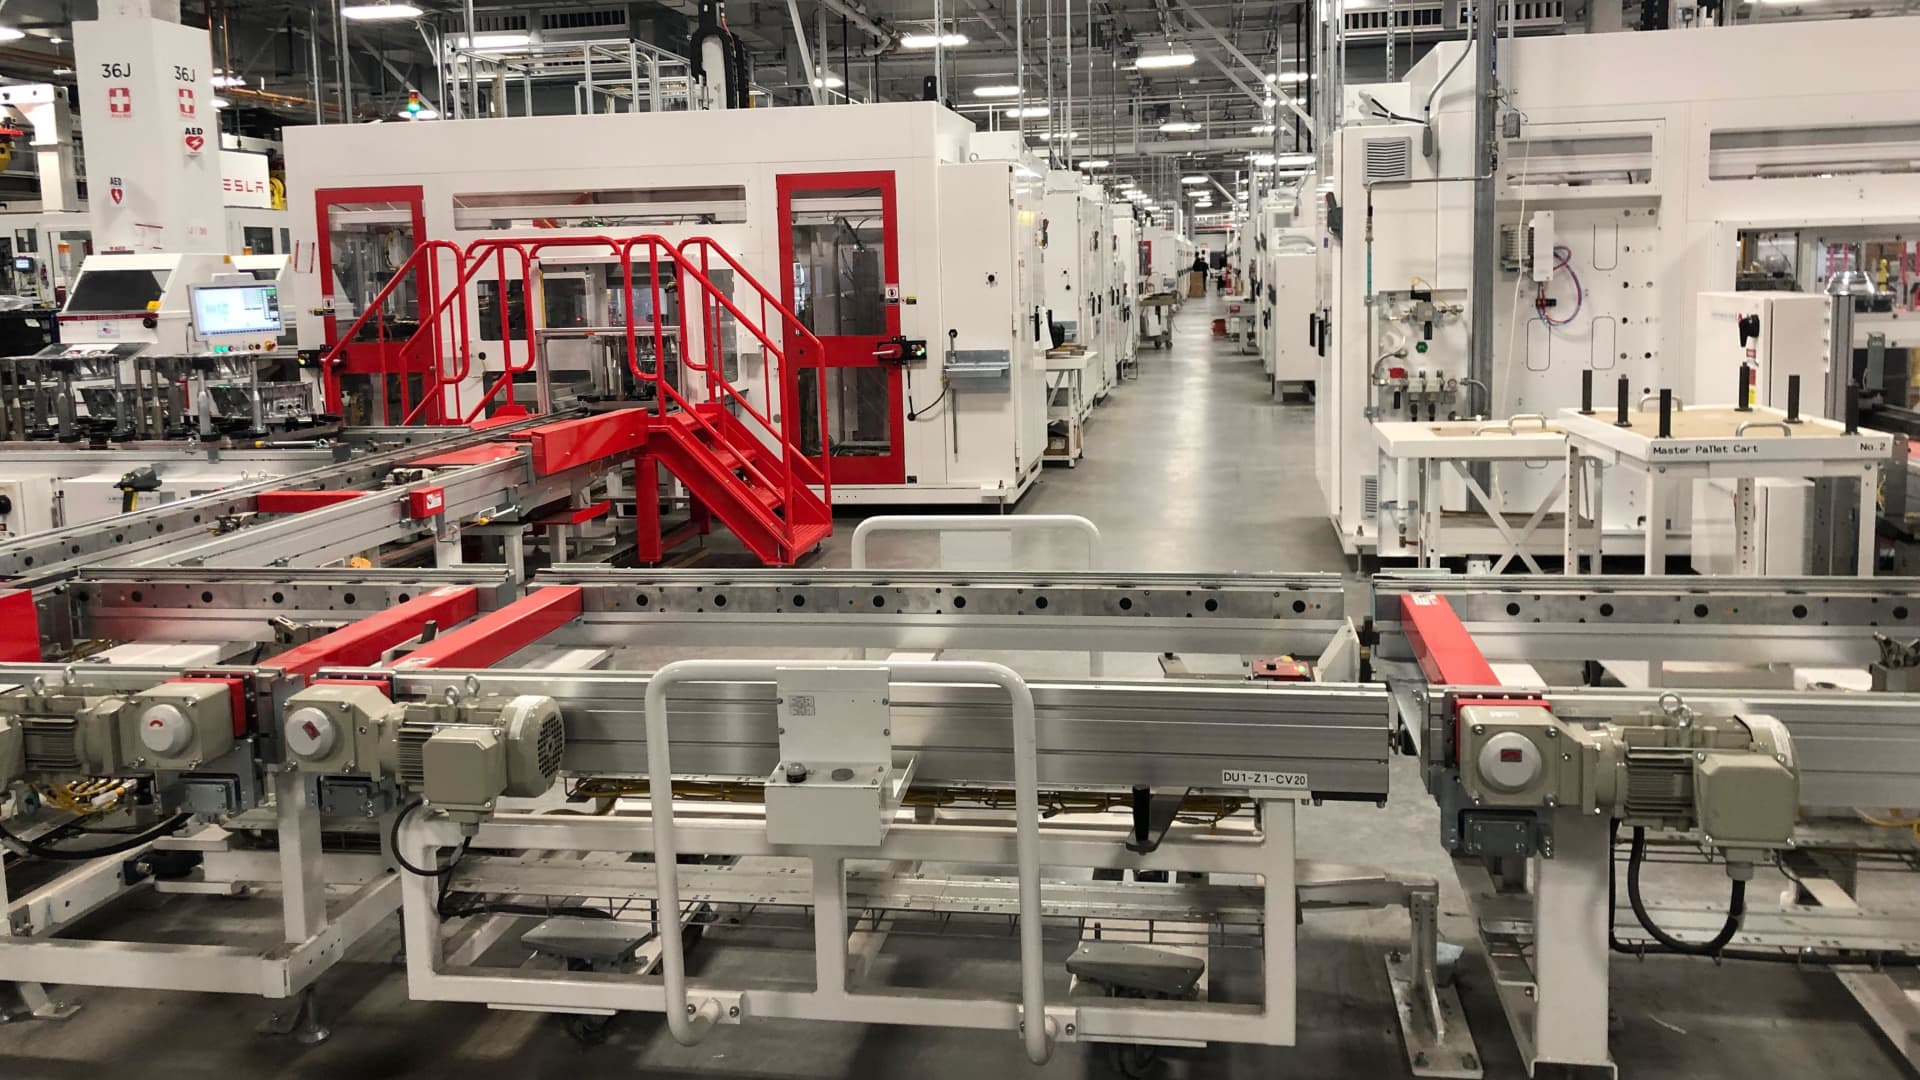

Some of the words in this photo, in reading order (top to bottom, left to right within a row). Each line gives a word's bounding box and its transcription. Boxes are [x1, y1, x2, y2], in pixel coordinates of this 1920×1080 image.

[101, 63, 131, 78] 36J
[174, 65, 196, 82] 36J
[185, 127, 203, 135] AED
[110, 177, 122, 186] AED
[222, 178, 264, 193] ESLA
[1653, 446, 1690, 454] Master
[1696, 445, 1728, 454] Pallet
[1733, 444, 1758, 453] Cart
[1223, 771, 1306, 785] DU1-Z1-CV20
